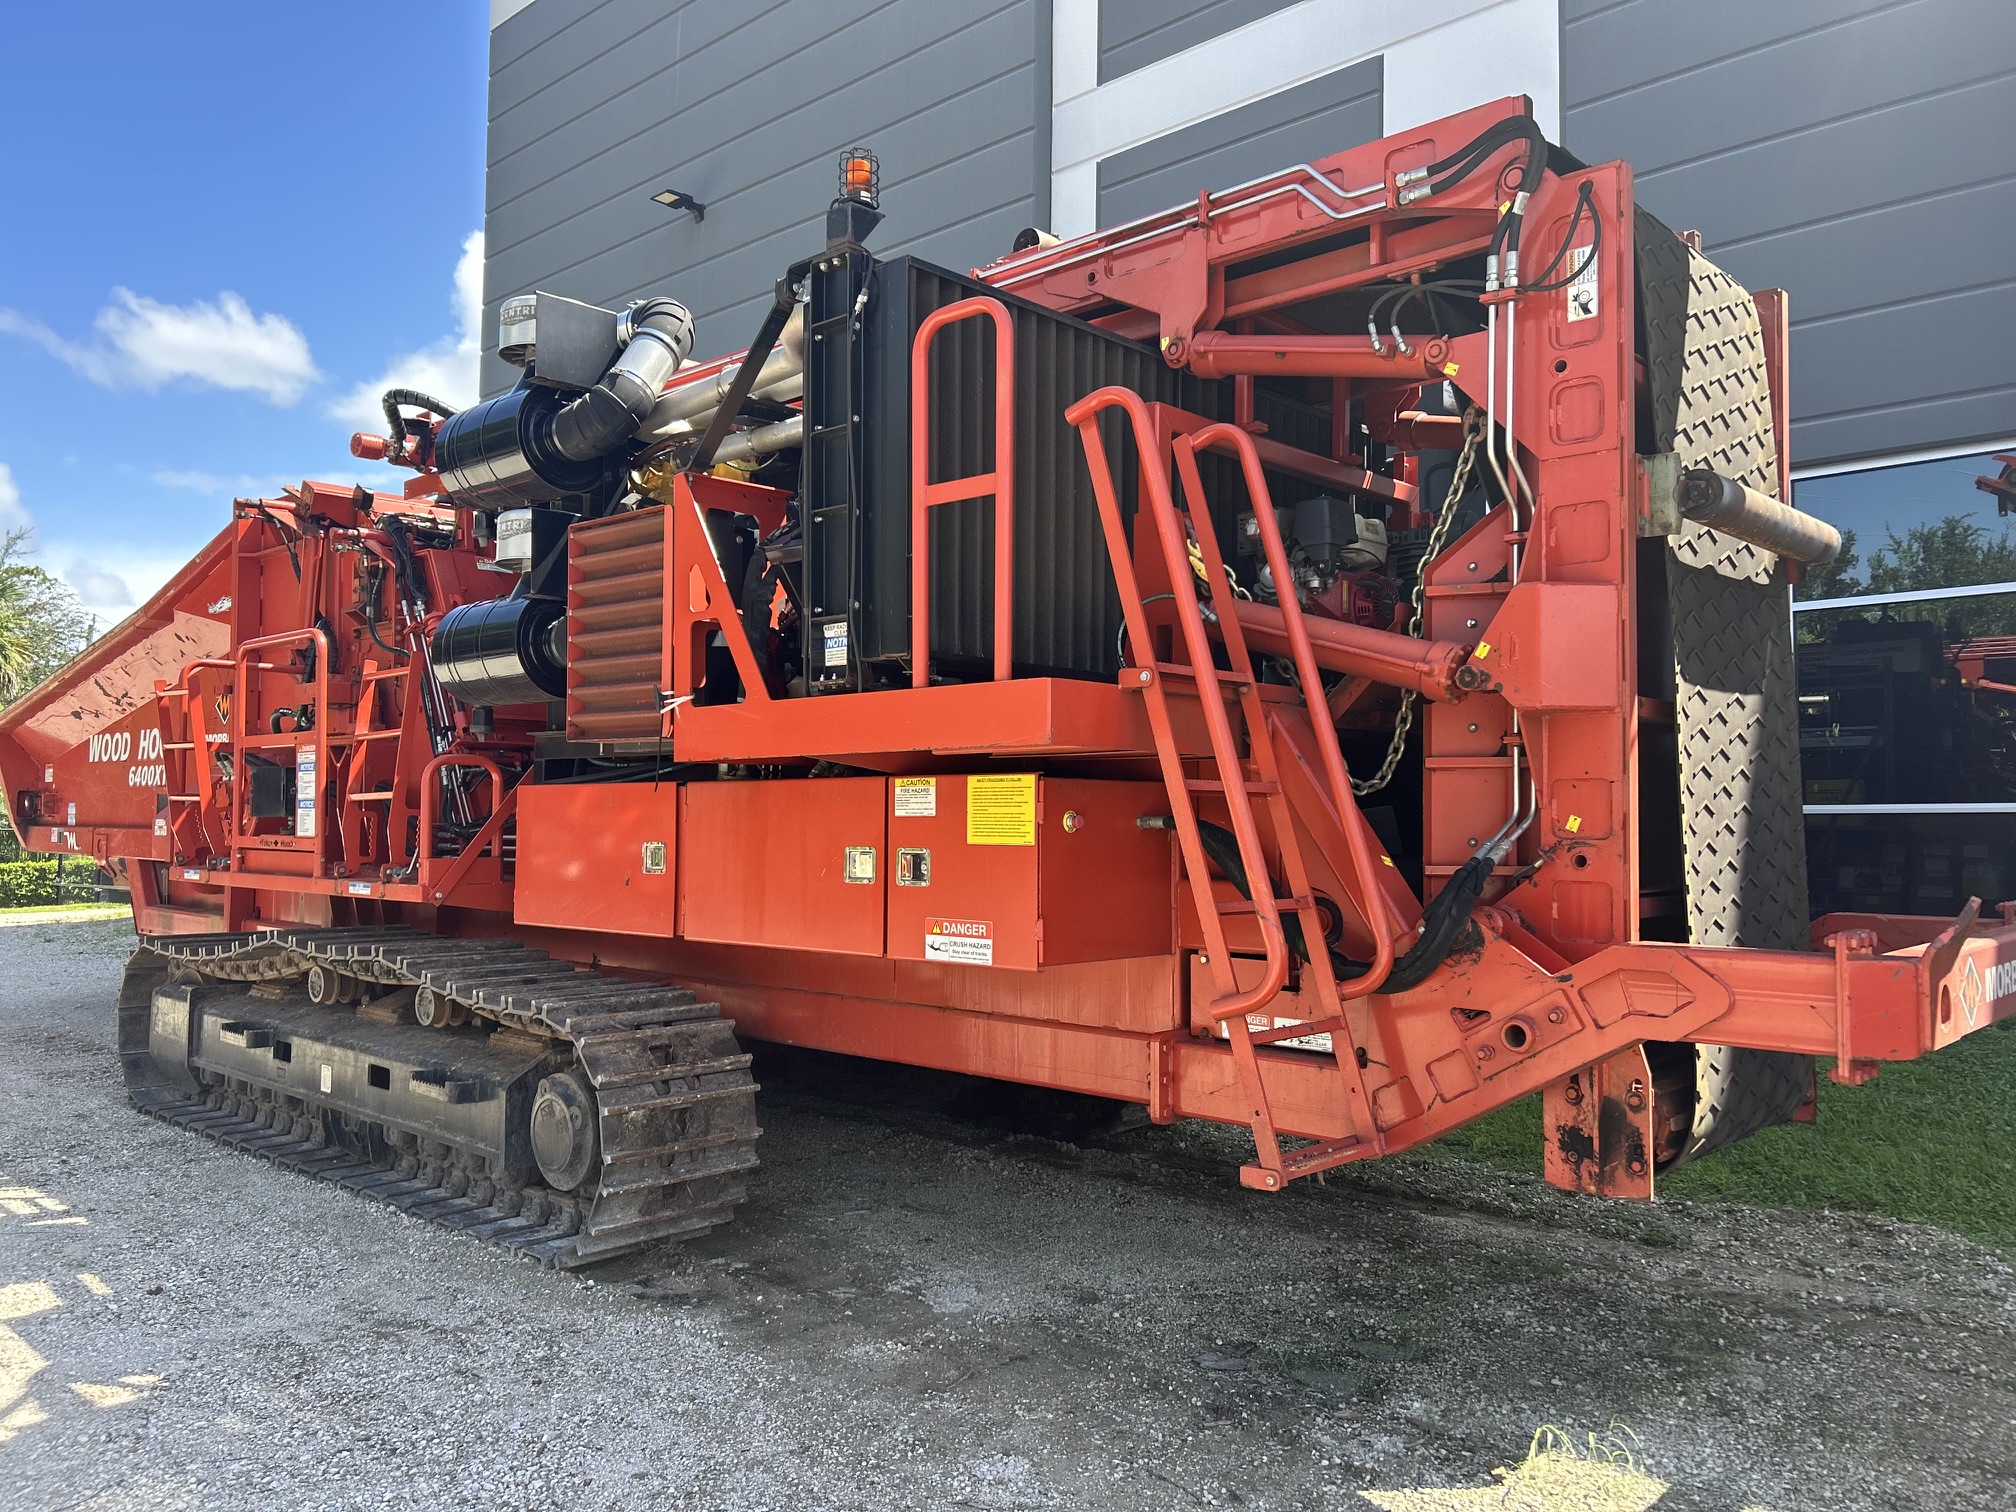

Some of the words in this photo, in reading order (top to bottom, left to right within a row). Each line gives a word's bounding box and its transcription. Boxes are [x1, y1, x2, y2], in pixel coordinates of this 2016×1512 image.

[89, 731, 131, 763] WOOD
[137, 728, 164, 760] HO
[942, 922, 987, 937] DANGER
[949, 940, 968, 948] CRUSH
[968, 942, 991, 951] HAZARD
[1985, 960, 2016, 1003] MORB
[1246, 1015, 1267, 1025] NGER
